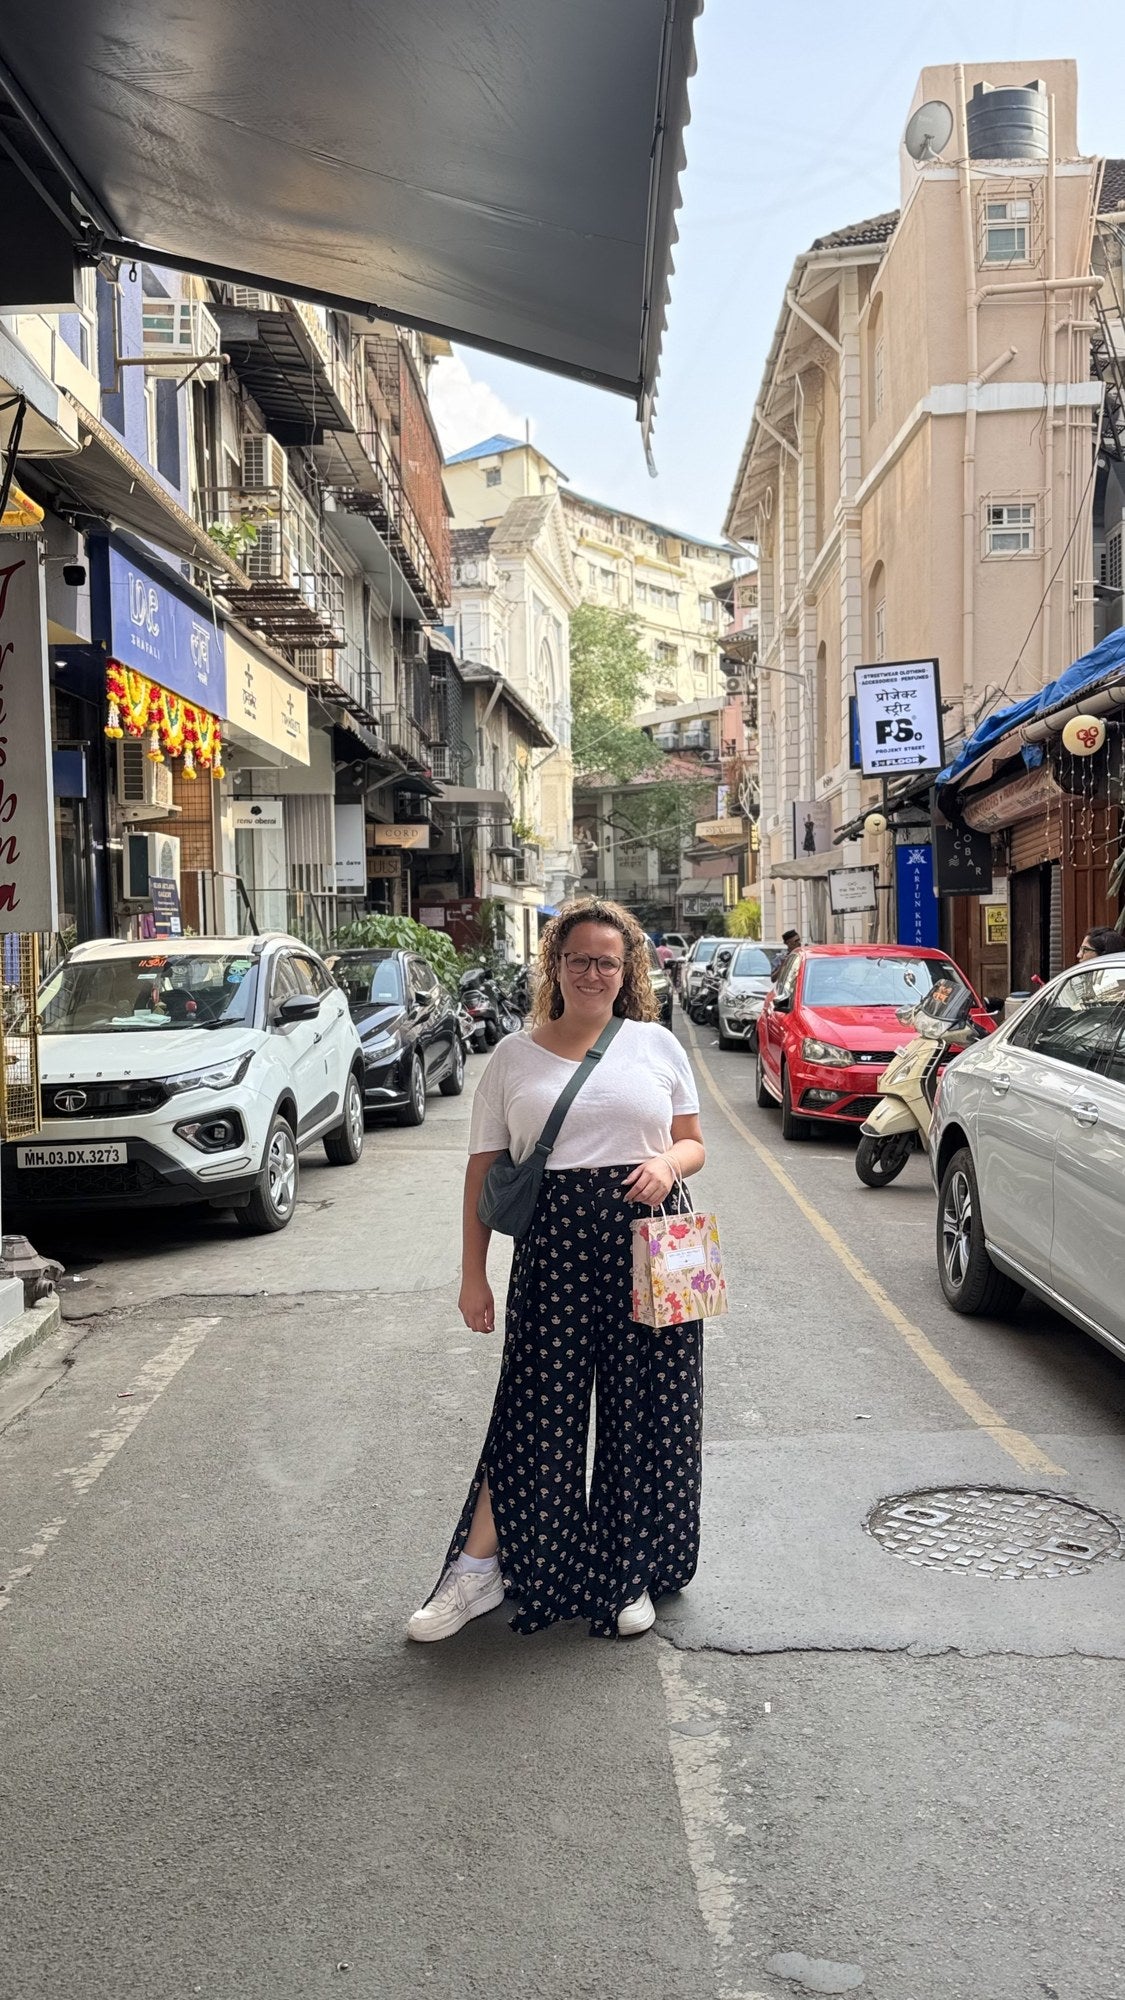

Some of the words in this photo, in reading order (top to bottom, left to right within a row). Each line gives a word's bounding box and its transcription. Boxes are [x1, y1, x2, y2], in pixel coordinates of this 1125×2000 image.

[863, 671, 899, 679] STREETWEAR
[861, 677, 898, 686] ACCESSORIES
[875, 688, 918, 702] प्रोजेक्ट
[884, 702, 911, 716] स्ट्रीट
[886, 757, 920, 766] FLOOR
[385, 829, 419, 837] CORD
[945, 822, 982, 876] NICOBAR
[914, 912, 922, 946] KHAN
[42, 1070, 132, 1080] EXON
[24, 1149, 120, 1166] MH.03.DX.3273
